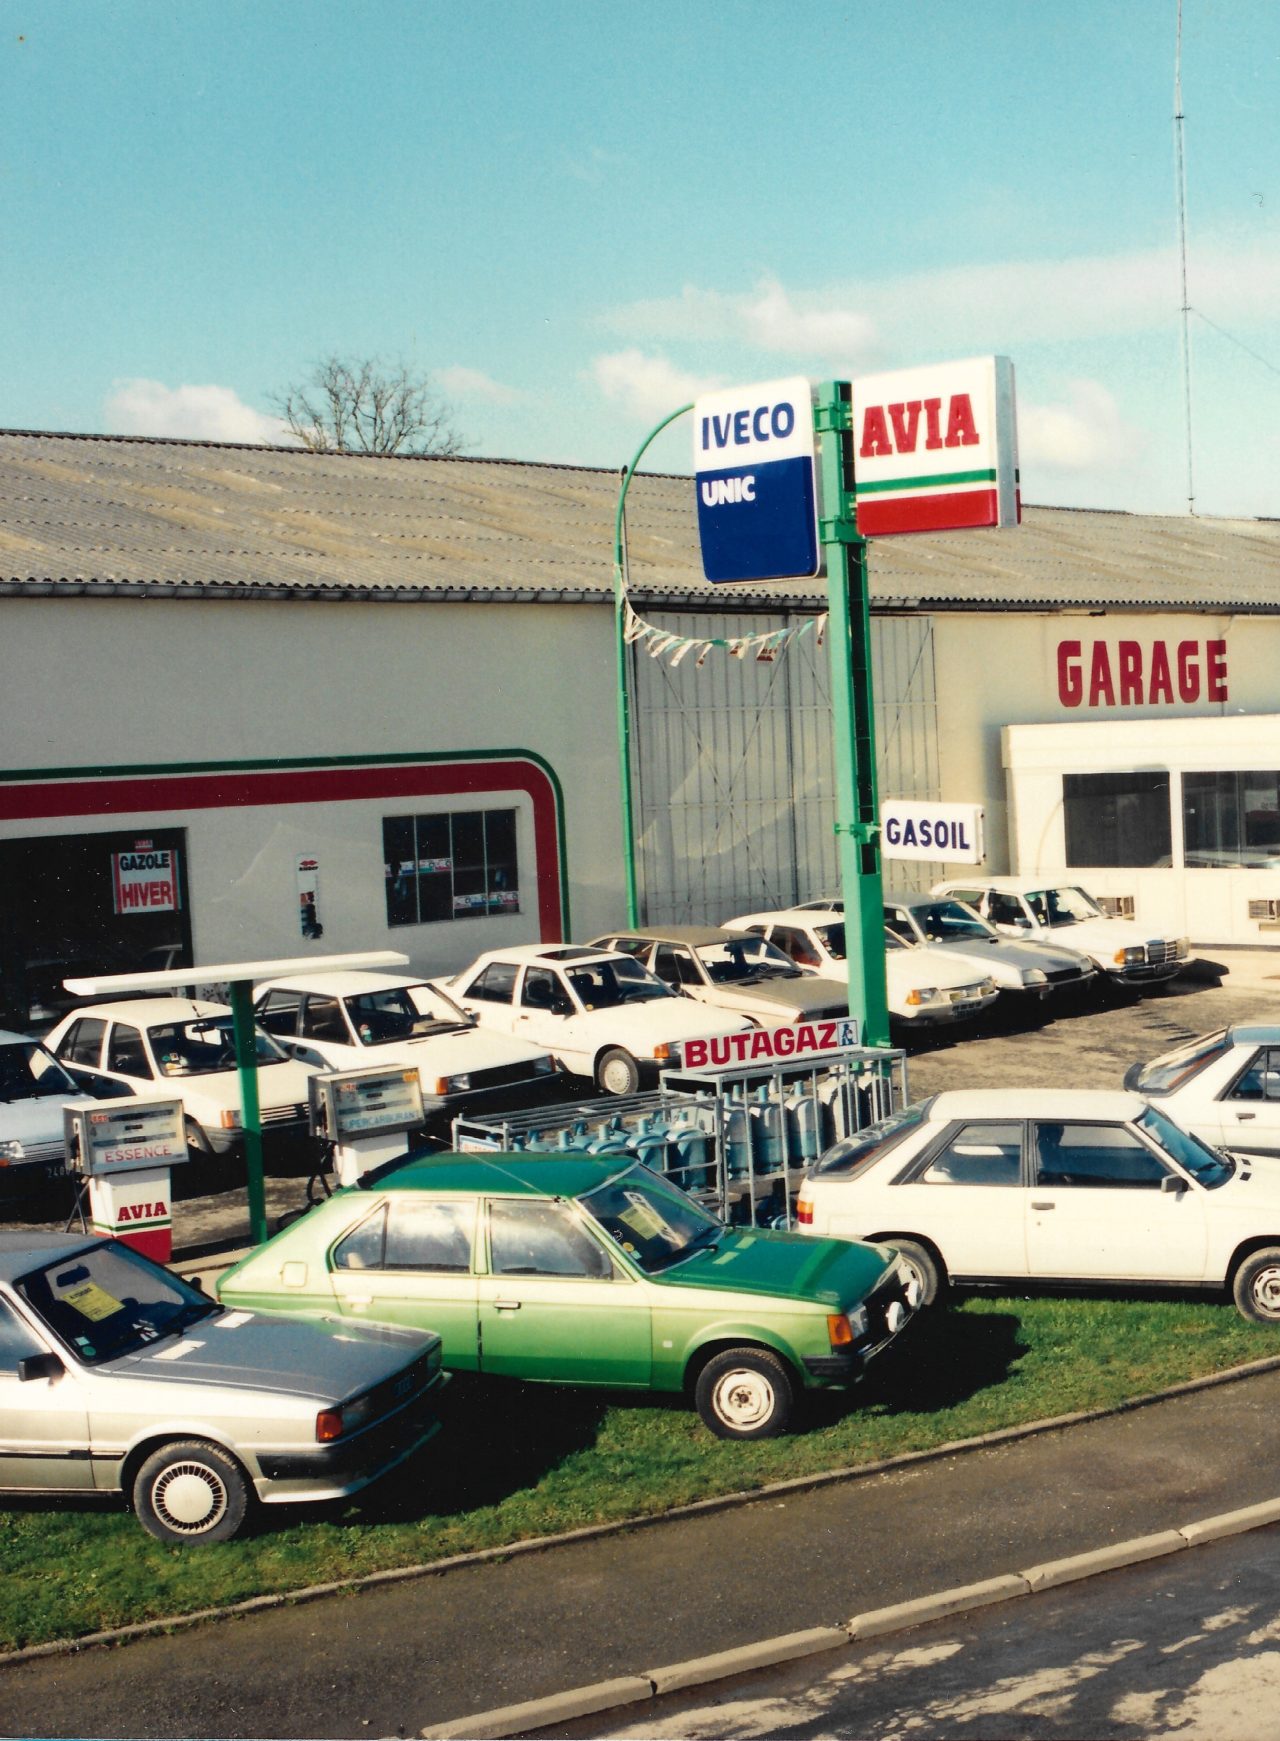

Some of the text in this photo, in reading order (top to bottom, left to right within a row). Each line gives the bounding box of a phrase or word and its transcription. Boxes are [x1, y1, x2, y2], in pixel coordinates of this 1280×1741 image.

[702, 402, 795, 450] IVECO
[860, 394, 980, 458] AVIA
[702, 475, 756, 507] UNIC
[1057, 640, 1228, 708] GARAGE
[886, 817, 970, 850] GASOIL
[120, 853, 170, 871] GAZOLE
[122, 881, 172, 908] HIVER
[685, 1022, 838, 1068] BUTAGAZ
[104, 1144, 173, 1163] ESSENCE
[117, 1202, 168, 1221] AVIA
